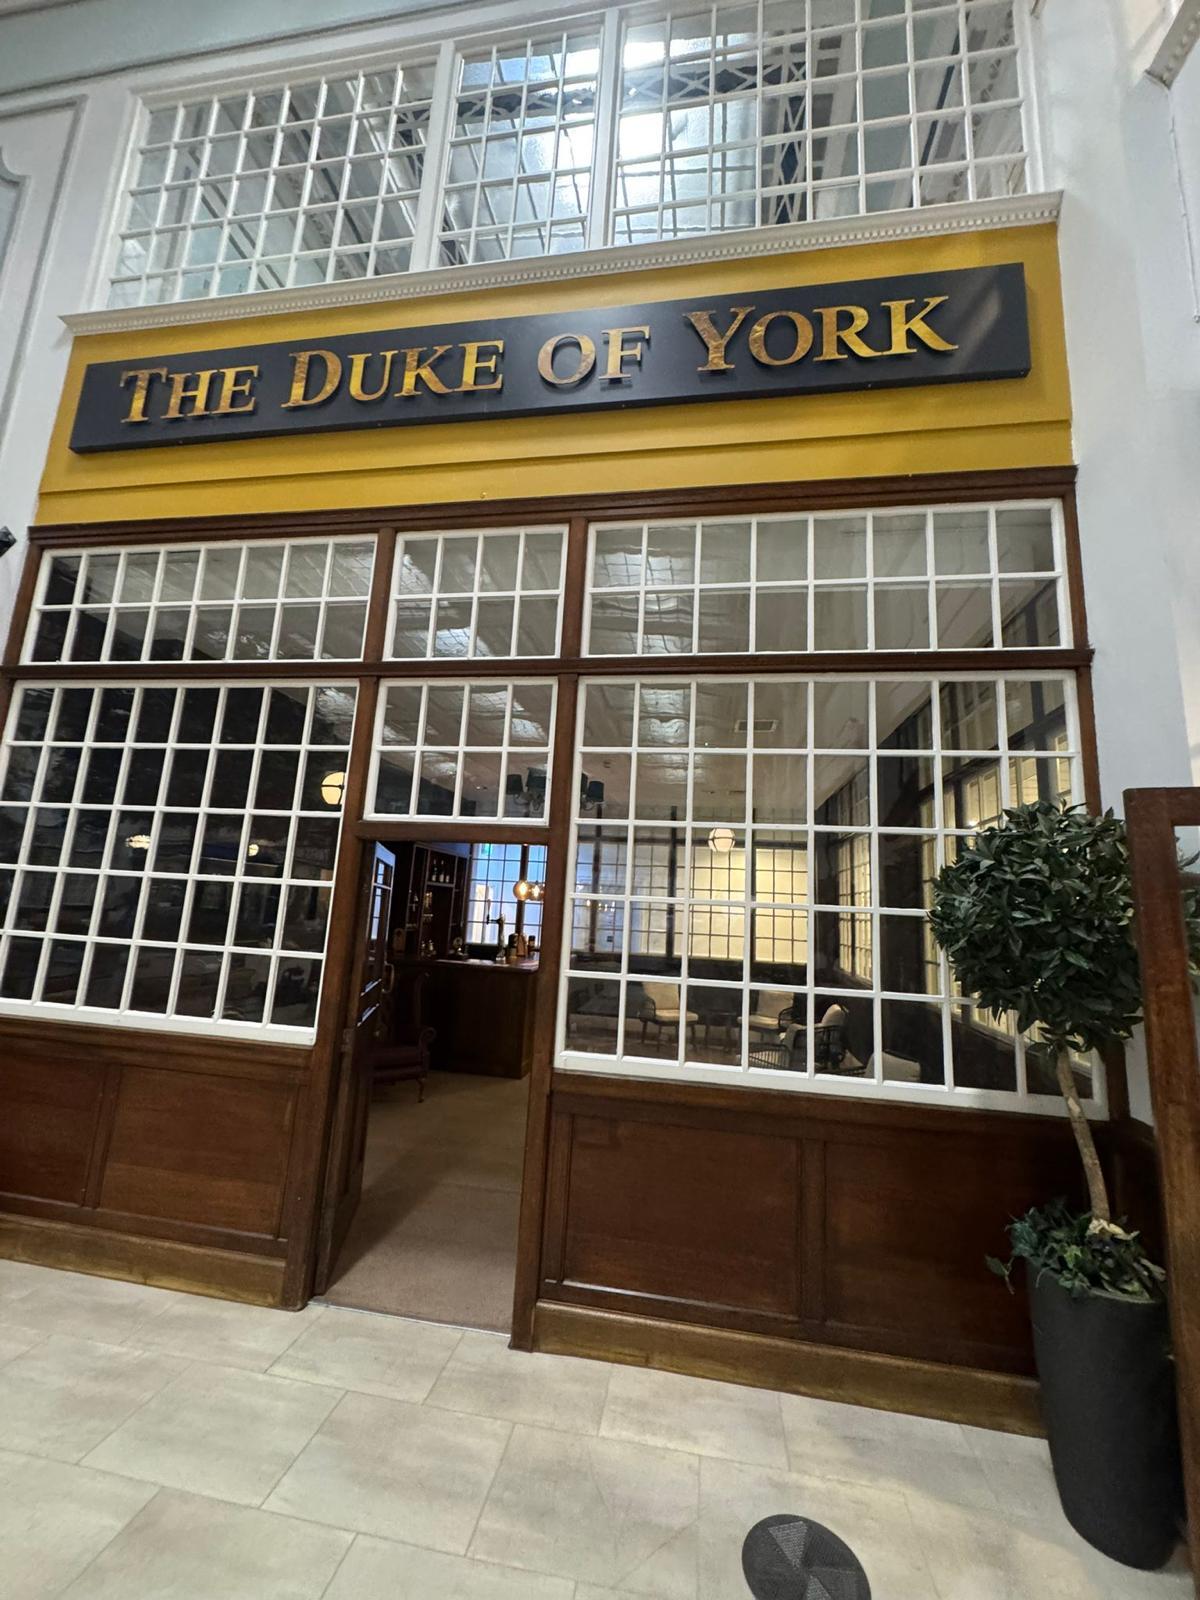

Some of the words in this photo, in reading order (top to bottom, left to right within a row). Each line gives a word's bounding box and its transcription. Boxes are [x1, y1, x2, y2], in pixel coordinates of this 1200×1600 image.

[120, 365, 259, 423] THE
[280, 340, 504, 409] DUKE
[537, 325, 651, 385] OF
[682, 295, 959, 372] YORK
